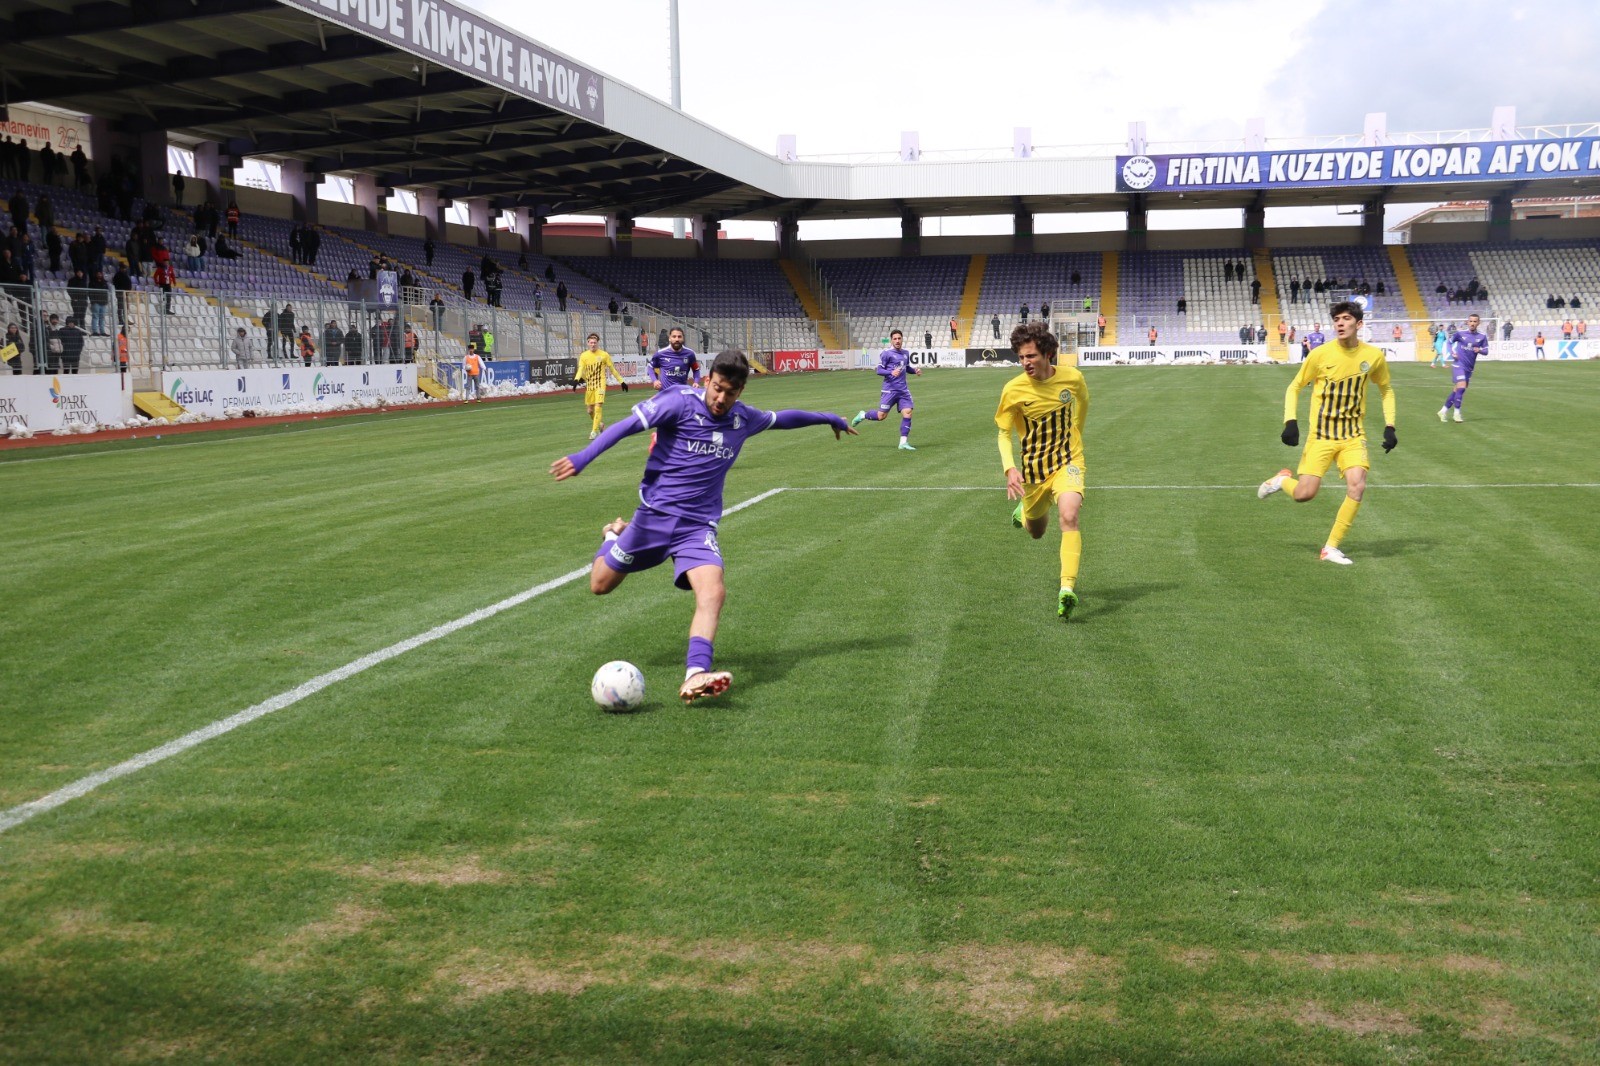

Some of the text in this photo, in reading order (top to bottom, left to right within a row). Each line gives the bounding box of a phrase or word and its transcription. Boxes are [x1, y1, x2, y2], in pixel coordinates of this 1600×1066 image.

[411, 0, 514, 83] KİMSEYE
[519, 47, 581, 109] AFYOK
[1166, 155, 1261, 186] FIRTINA
[1268, 150, 1384, 182] KUZEYDE
[1391, 147, 1481, 178] KOPAR
[1487, 141, 1583, 174] AFYOK
[1501, 342, 1529, 351] GRUP
[1084, 351, 1111, 361] PUMA
[1128, 350, 1157, 360] PUMA
[1174, 350, 1202, 360] PUMA
[1220, 350, 1248, 359] PUMA
[317, 381, 345, 397] HES İLAÇ
[385, 385, 414, 397] VIAPECIA
[60, 394, 88, 410] PARK
[176, 387, 214, 406] HES İLAÇ
[222, 396, 262, 409] DERMAVIA
[267, 392, 305, 405] VIAPECIA
